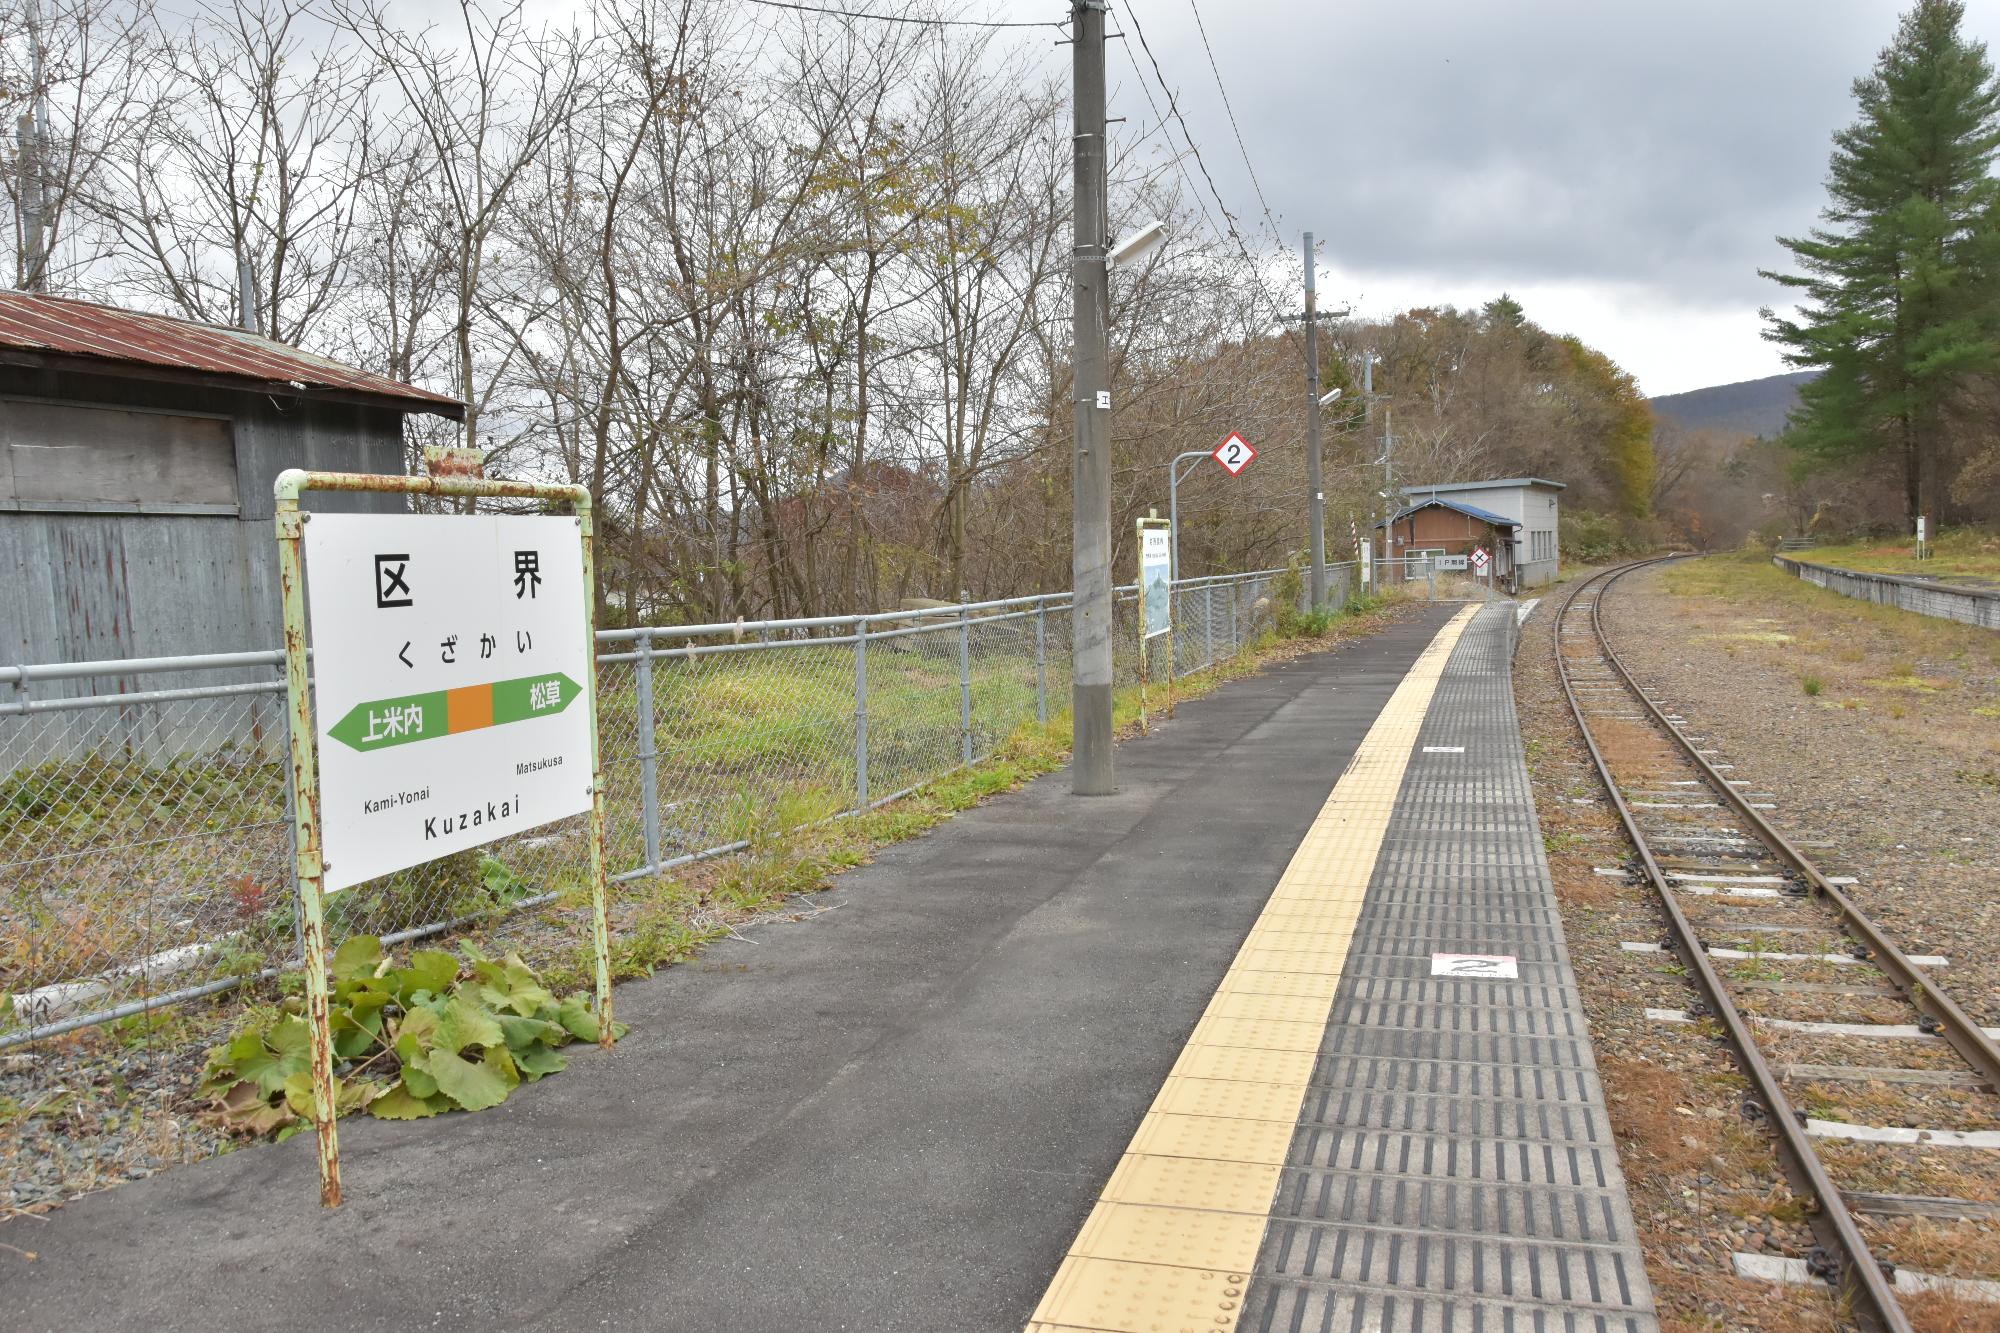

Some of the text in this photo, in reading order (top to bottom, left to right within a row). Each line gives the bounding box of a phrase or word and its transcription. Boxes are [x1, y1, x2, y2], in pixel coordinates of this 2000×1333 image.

[1227, 444, 1241, 464] 2
[374, 551, 542, 608] 区界
[399, 631, 532, 668] くざかい
[530, 680, 561, 711] 松草
[361, 703, 423, 742] 上米内
[516, 754, 563, 775] Matsukusa
[364, 786, 430, 815] Kami-Yonai
[424, 794, 519, 840] Kuzakai
